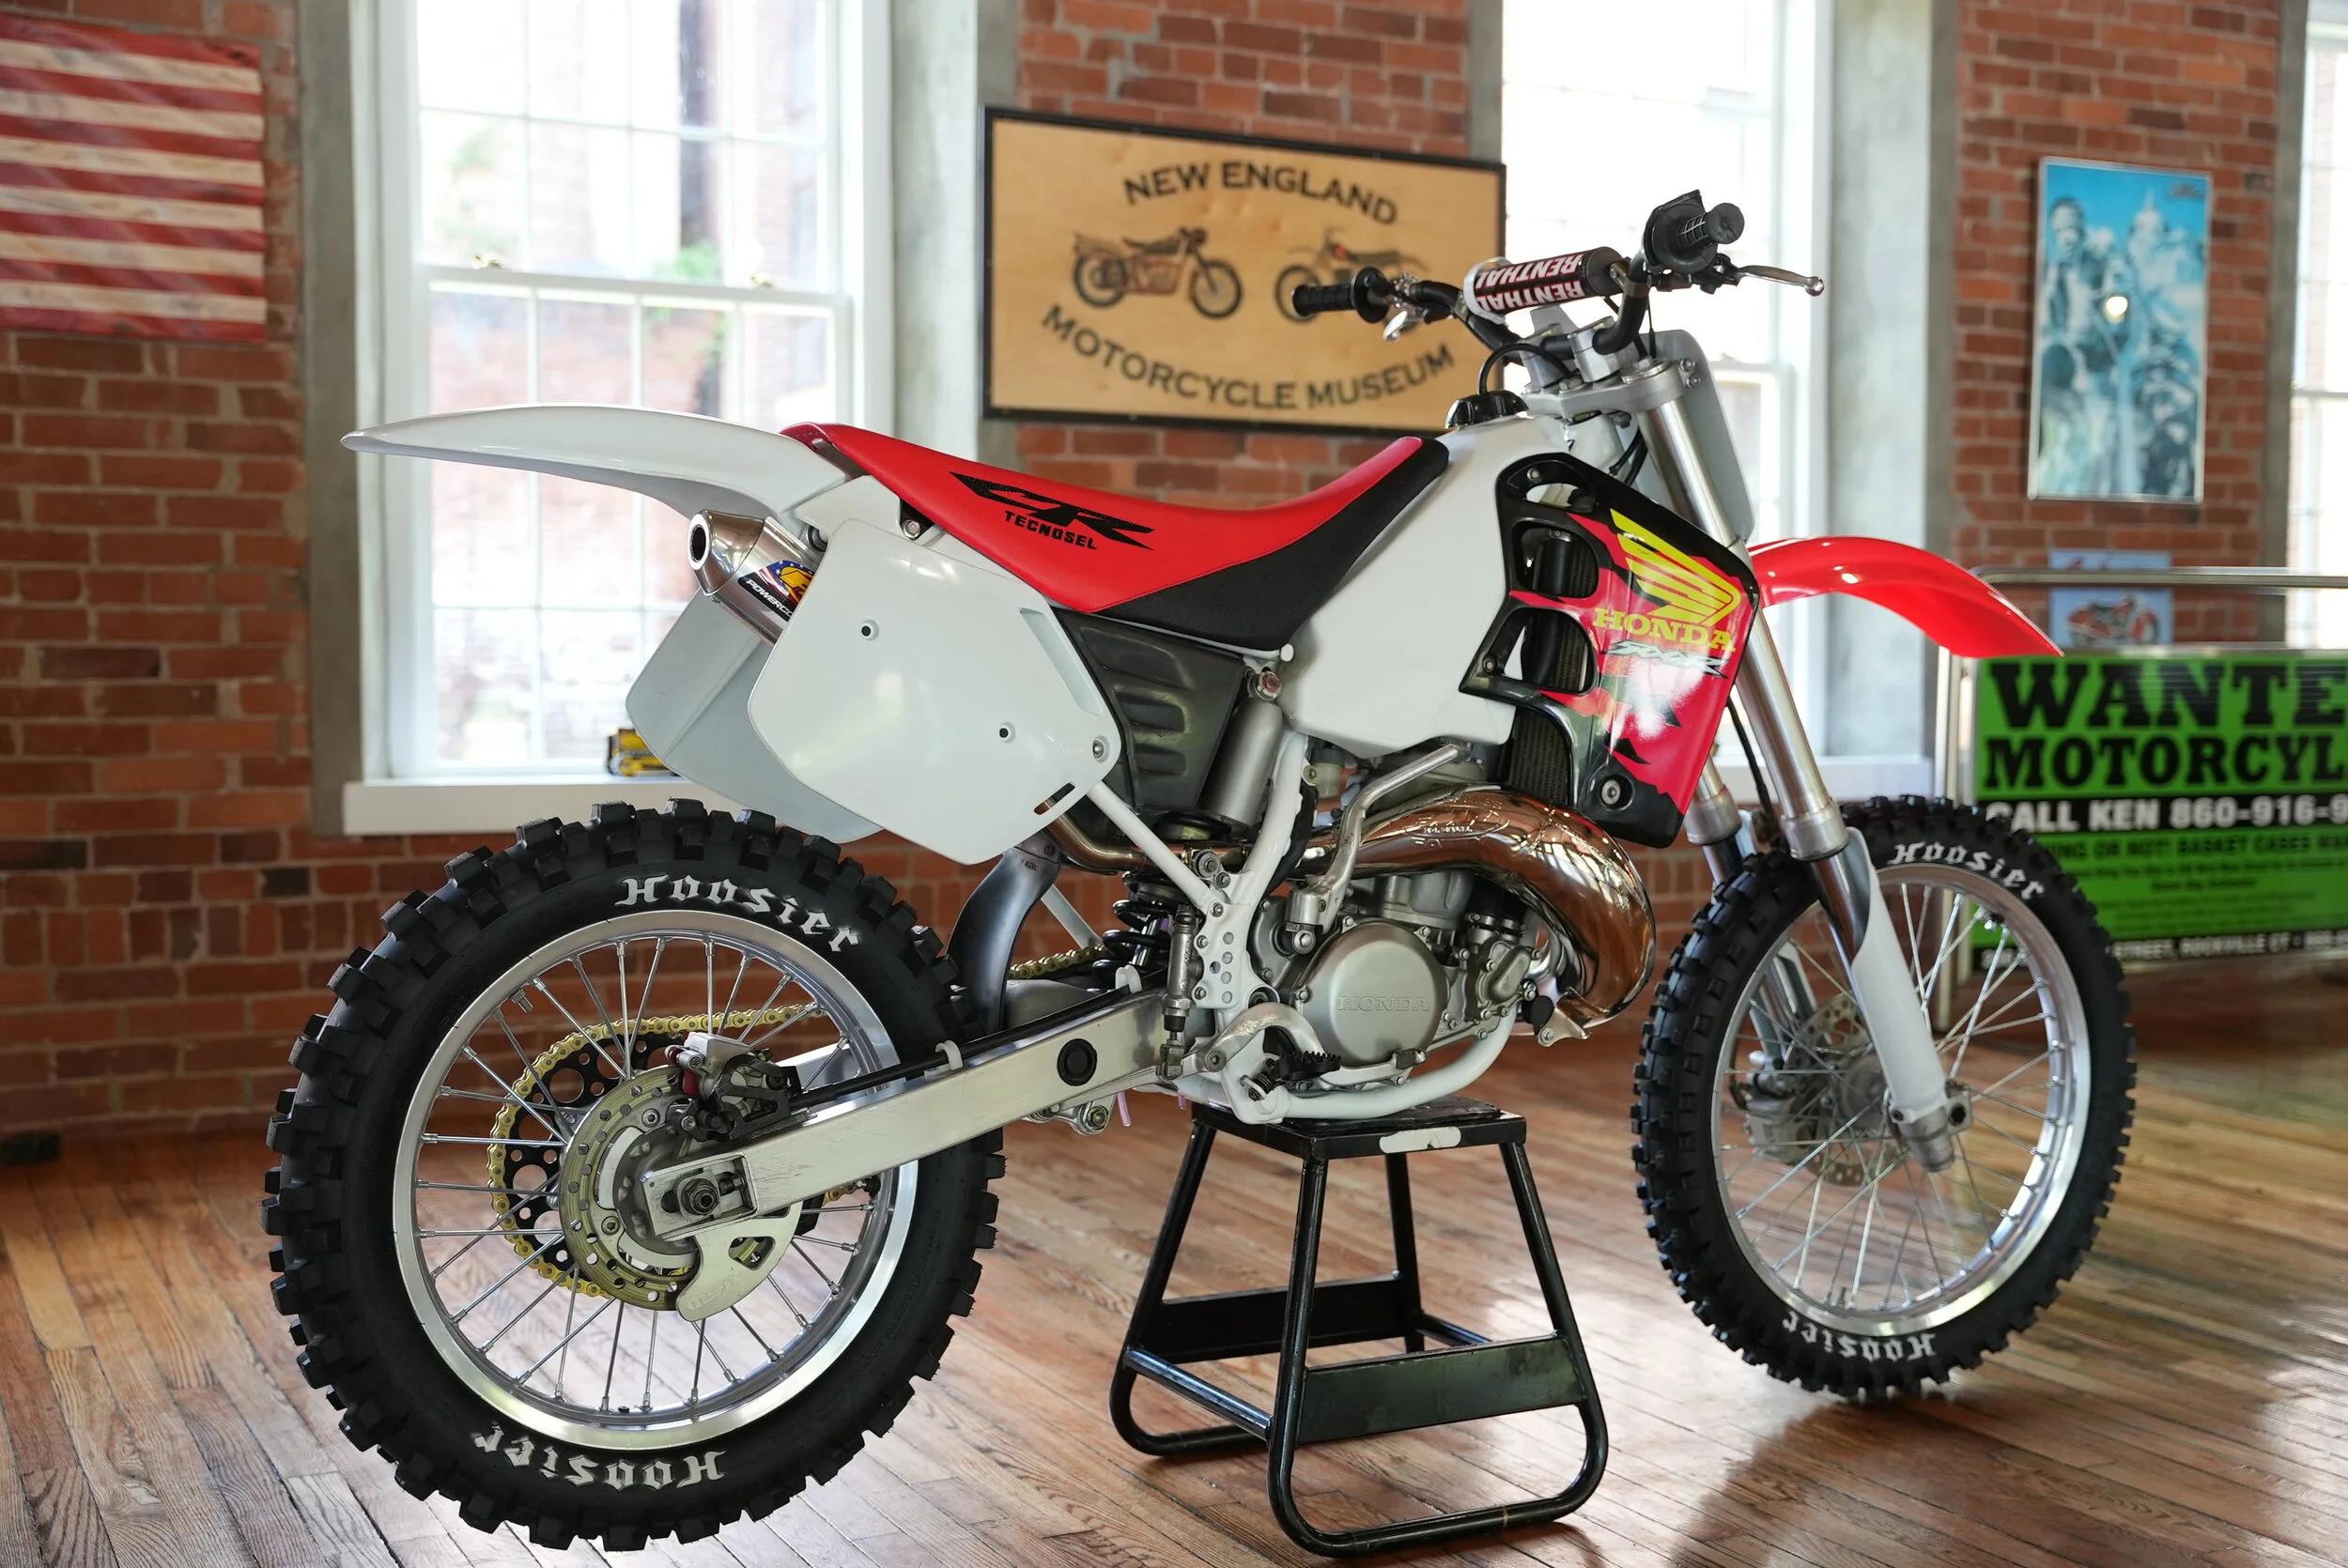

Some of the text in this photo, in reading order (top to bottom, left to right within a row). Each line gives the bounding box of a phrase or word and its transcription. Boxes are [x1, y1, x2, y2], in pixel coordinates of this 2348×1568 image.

[1124, 161, 1398, 225] NEW ENGLAND
[1475, 254, 1585, 289] RENTHAL
[1477, 281, 1585, 312] RENTHAL
[1043, 303, 1455, 410] MOTORCYCLE MUSEUM
[1004, 510, 1097, 550] TECNOSEL
[1593, 607, 1736, 653] HONDA
[1989, 663, 2347, 728] WANTE
[1985, 737, 2344, 788] MOTORCYL
[2088, 799, 2159, 832] KEN
[1887, 841, 2045, 899] Hoosier
[614, 874, 858, 952] Hoosier
[1336, 995, 1431, 1013] HONDA
[1782, 1311, 1937, 1362] Hoosier
[471, 1421, 727, 1492] Hoosier
